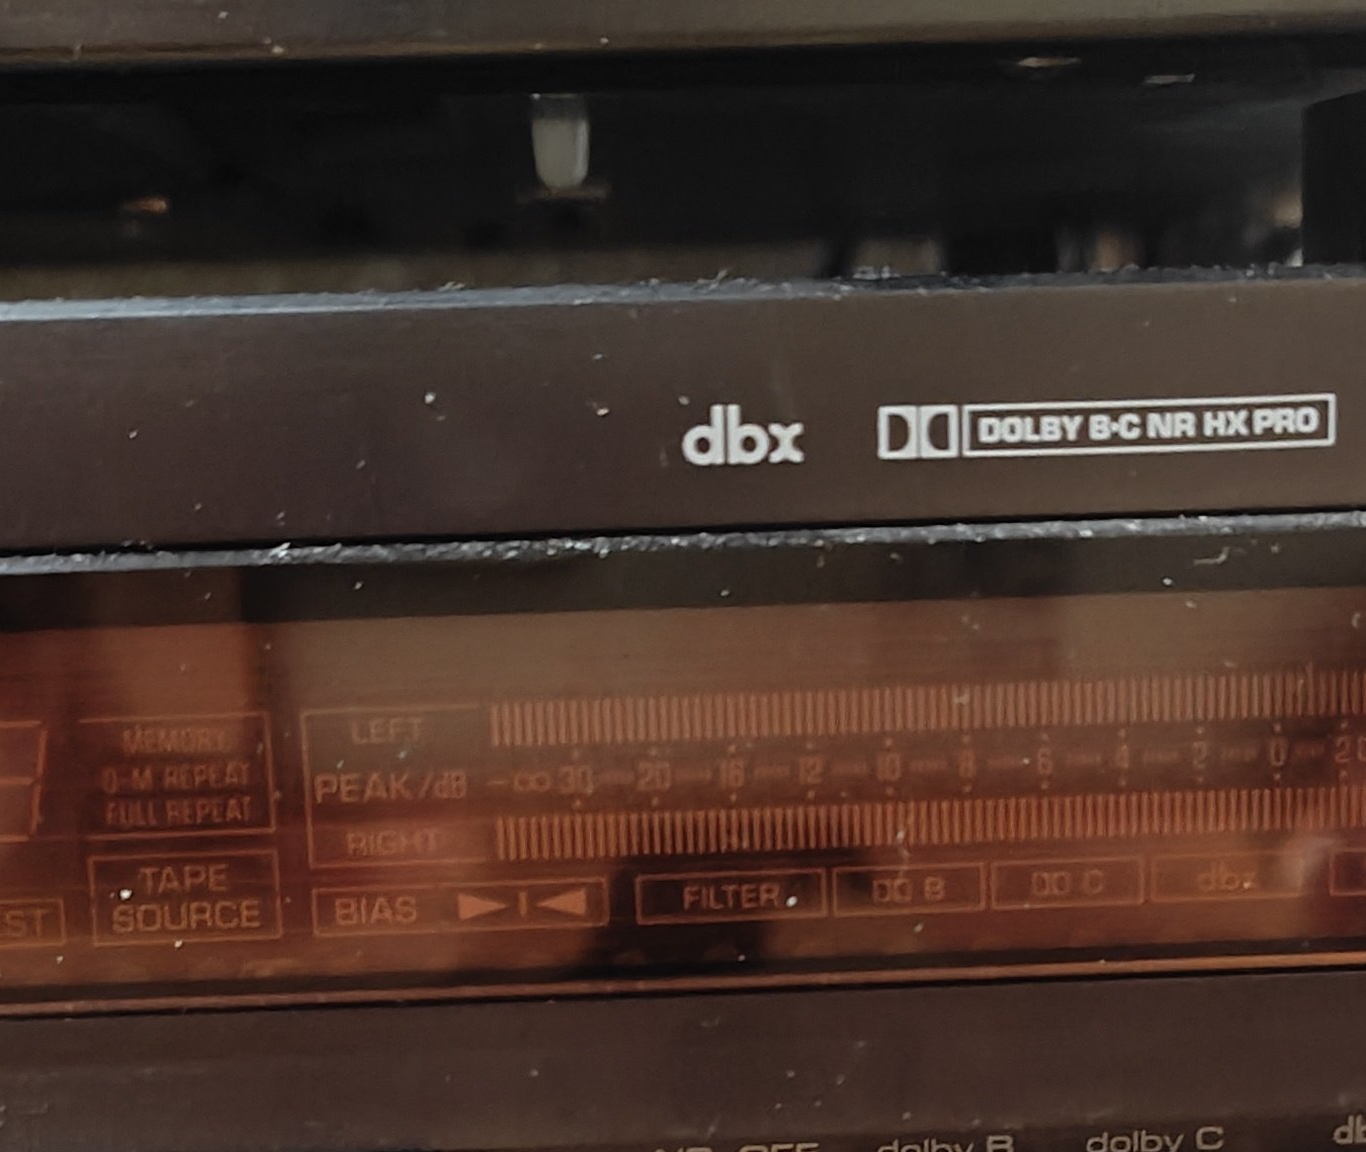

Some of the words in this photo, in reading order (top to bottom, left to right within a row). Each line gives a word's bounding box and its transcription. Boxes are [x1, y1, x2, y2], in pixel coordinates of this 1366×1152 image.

[682, 404, 804, 464] dbx
[977, 416, 1079, 443] DOLBY
[1146, 411, 1196, 438] NR
[1202, 410, 1251, 437] HX
[1252, 407, 1318, 434] PRO
[123, 726, 232, 754] MEMORY
[351, 717, 423, 745] LEFT
[164, 761, 250, 790] REPEAT
[105, 800, 157, 826] FULL
[165, 796, 251, 823] REPEAT
[138, 863, 229, 894] TAPE
[334, 896, 419, 926] BIAS
[683, 885, 779, 910] FILTER
[112, 900, 261, 933] SOURCE
[1195, 1127, 1225, 1151] C
